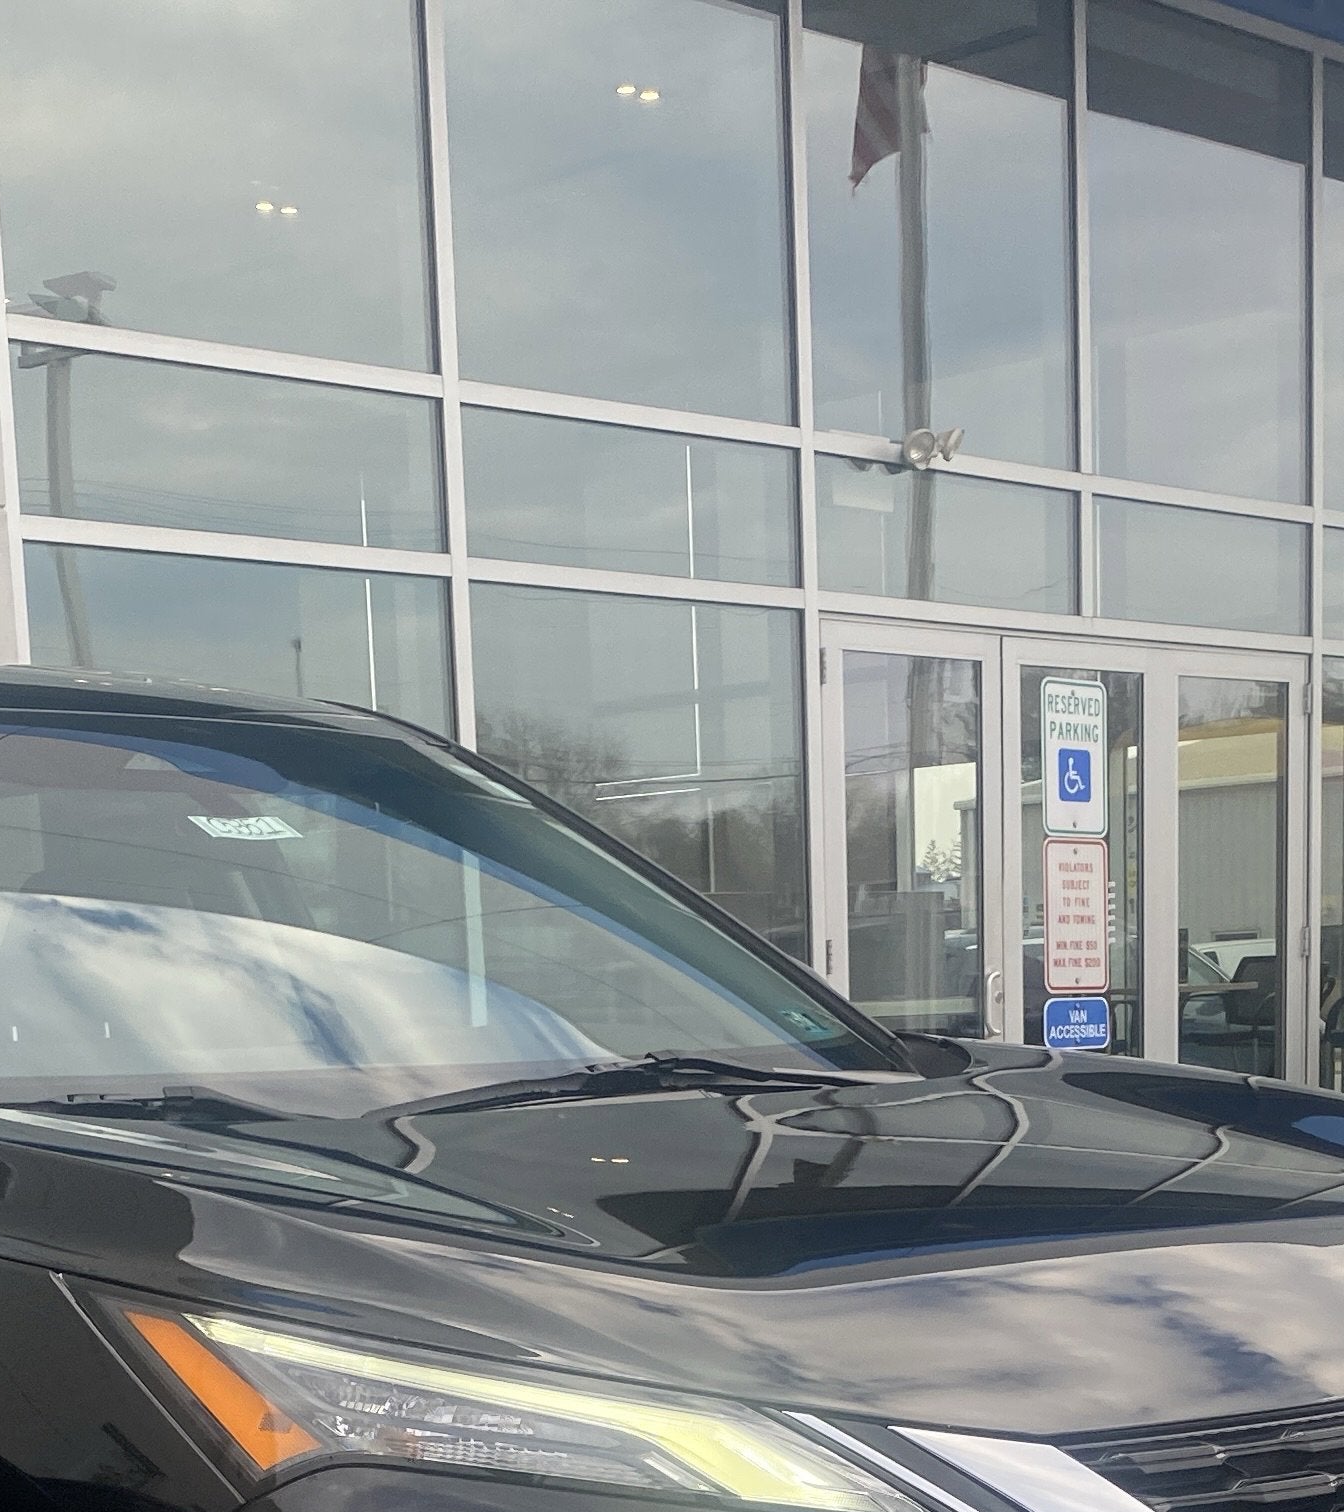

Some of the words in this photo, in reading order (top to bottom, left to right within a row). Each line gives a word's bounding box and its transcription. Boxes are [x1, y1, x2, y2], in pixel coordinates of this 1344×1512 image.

[1047, 694, 1100, 717] RESERVED
[1049, 721, 1099, 743] PARKING
[1058, 862, 1093, 873] VIOLATORS
[1062, 880, 1090, 890] SUBJECT
[1062, 897, 1071, 907] TO
[1075, 897, 1090, 908] FINE
[1057, 915, 1070, 925] AND
[1073, 915, 1096, 925] TOWING
[1070, 941, 1083, 951] FINE
[1068, 958, 1083, 968] FINE
[1068, 1009, 1088, 1024] VAN
[1048, 1024, 1106, 1040] ACCESSIBLE
